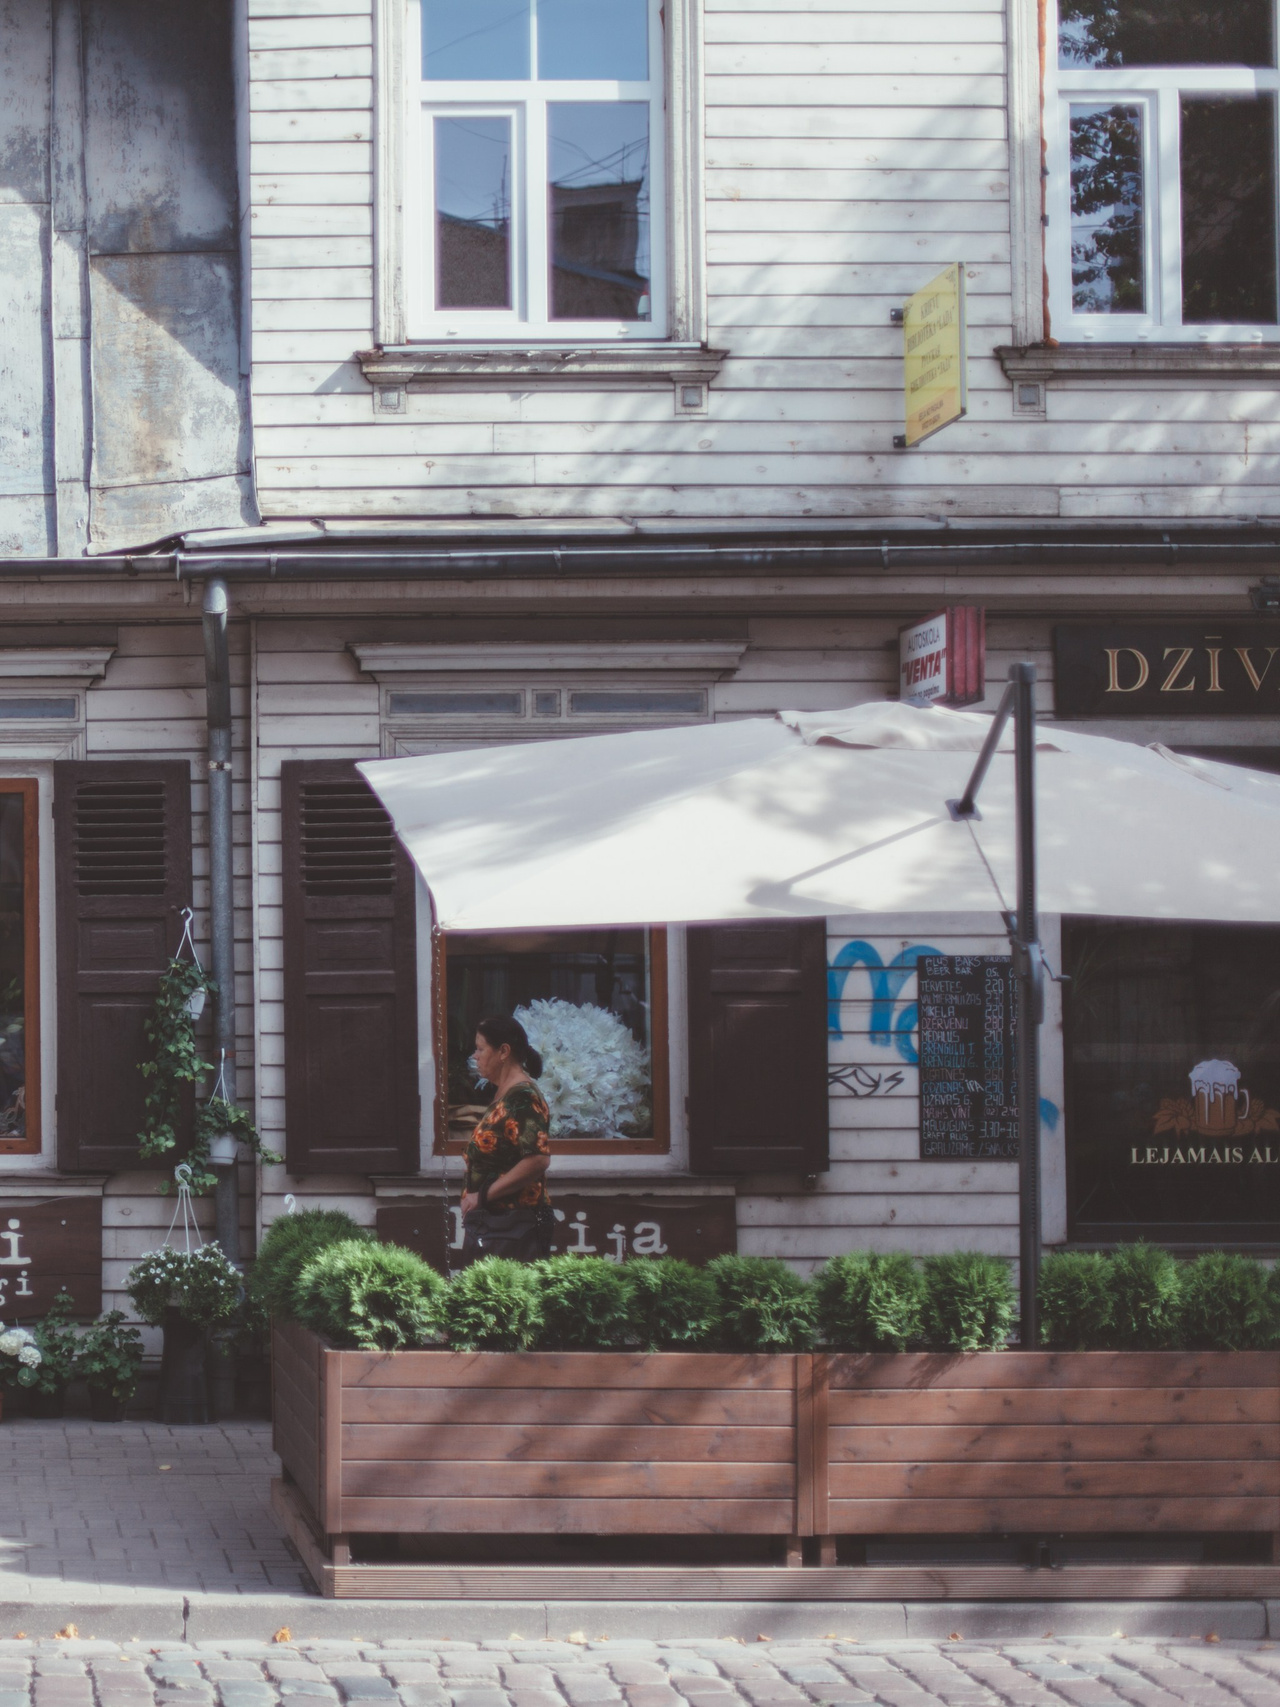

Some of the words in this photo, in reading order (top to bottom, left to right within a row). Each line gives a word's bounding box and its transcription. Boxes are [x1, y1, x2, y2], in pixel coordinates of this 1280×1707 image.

[908, 626, 940, 654] AUTOSKOLA
[1104, 636, 1280, 692] DZĪV
[954, 956, 981, 967] BARS
[926, 966, 950, 976] BEER
[954, 966, 973, 975] BAR
[1131, 1147, 1244, 1164] LEJAMAIS
[1249, 1147, 1280, 1164] AL
